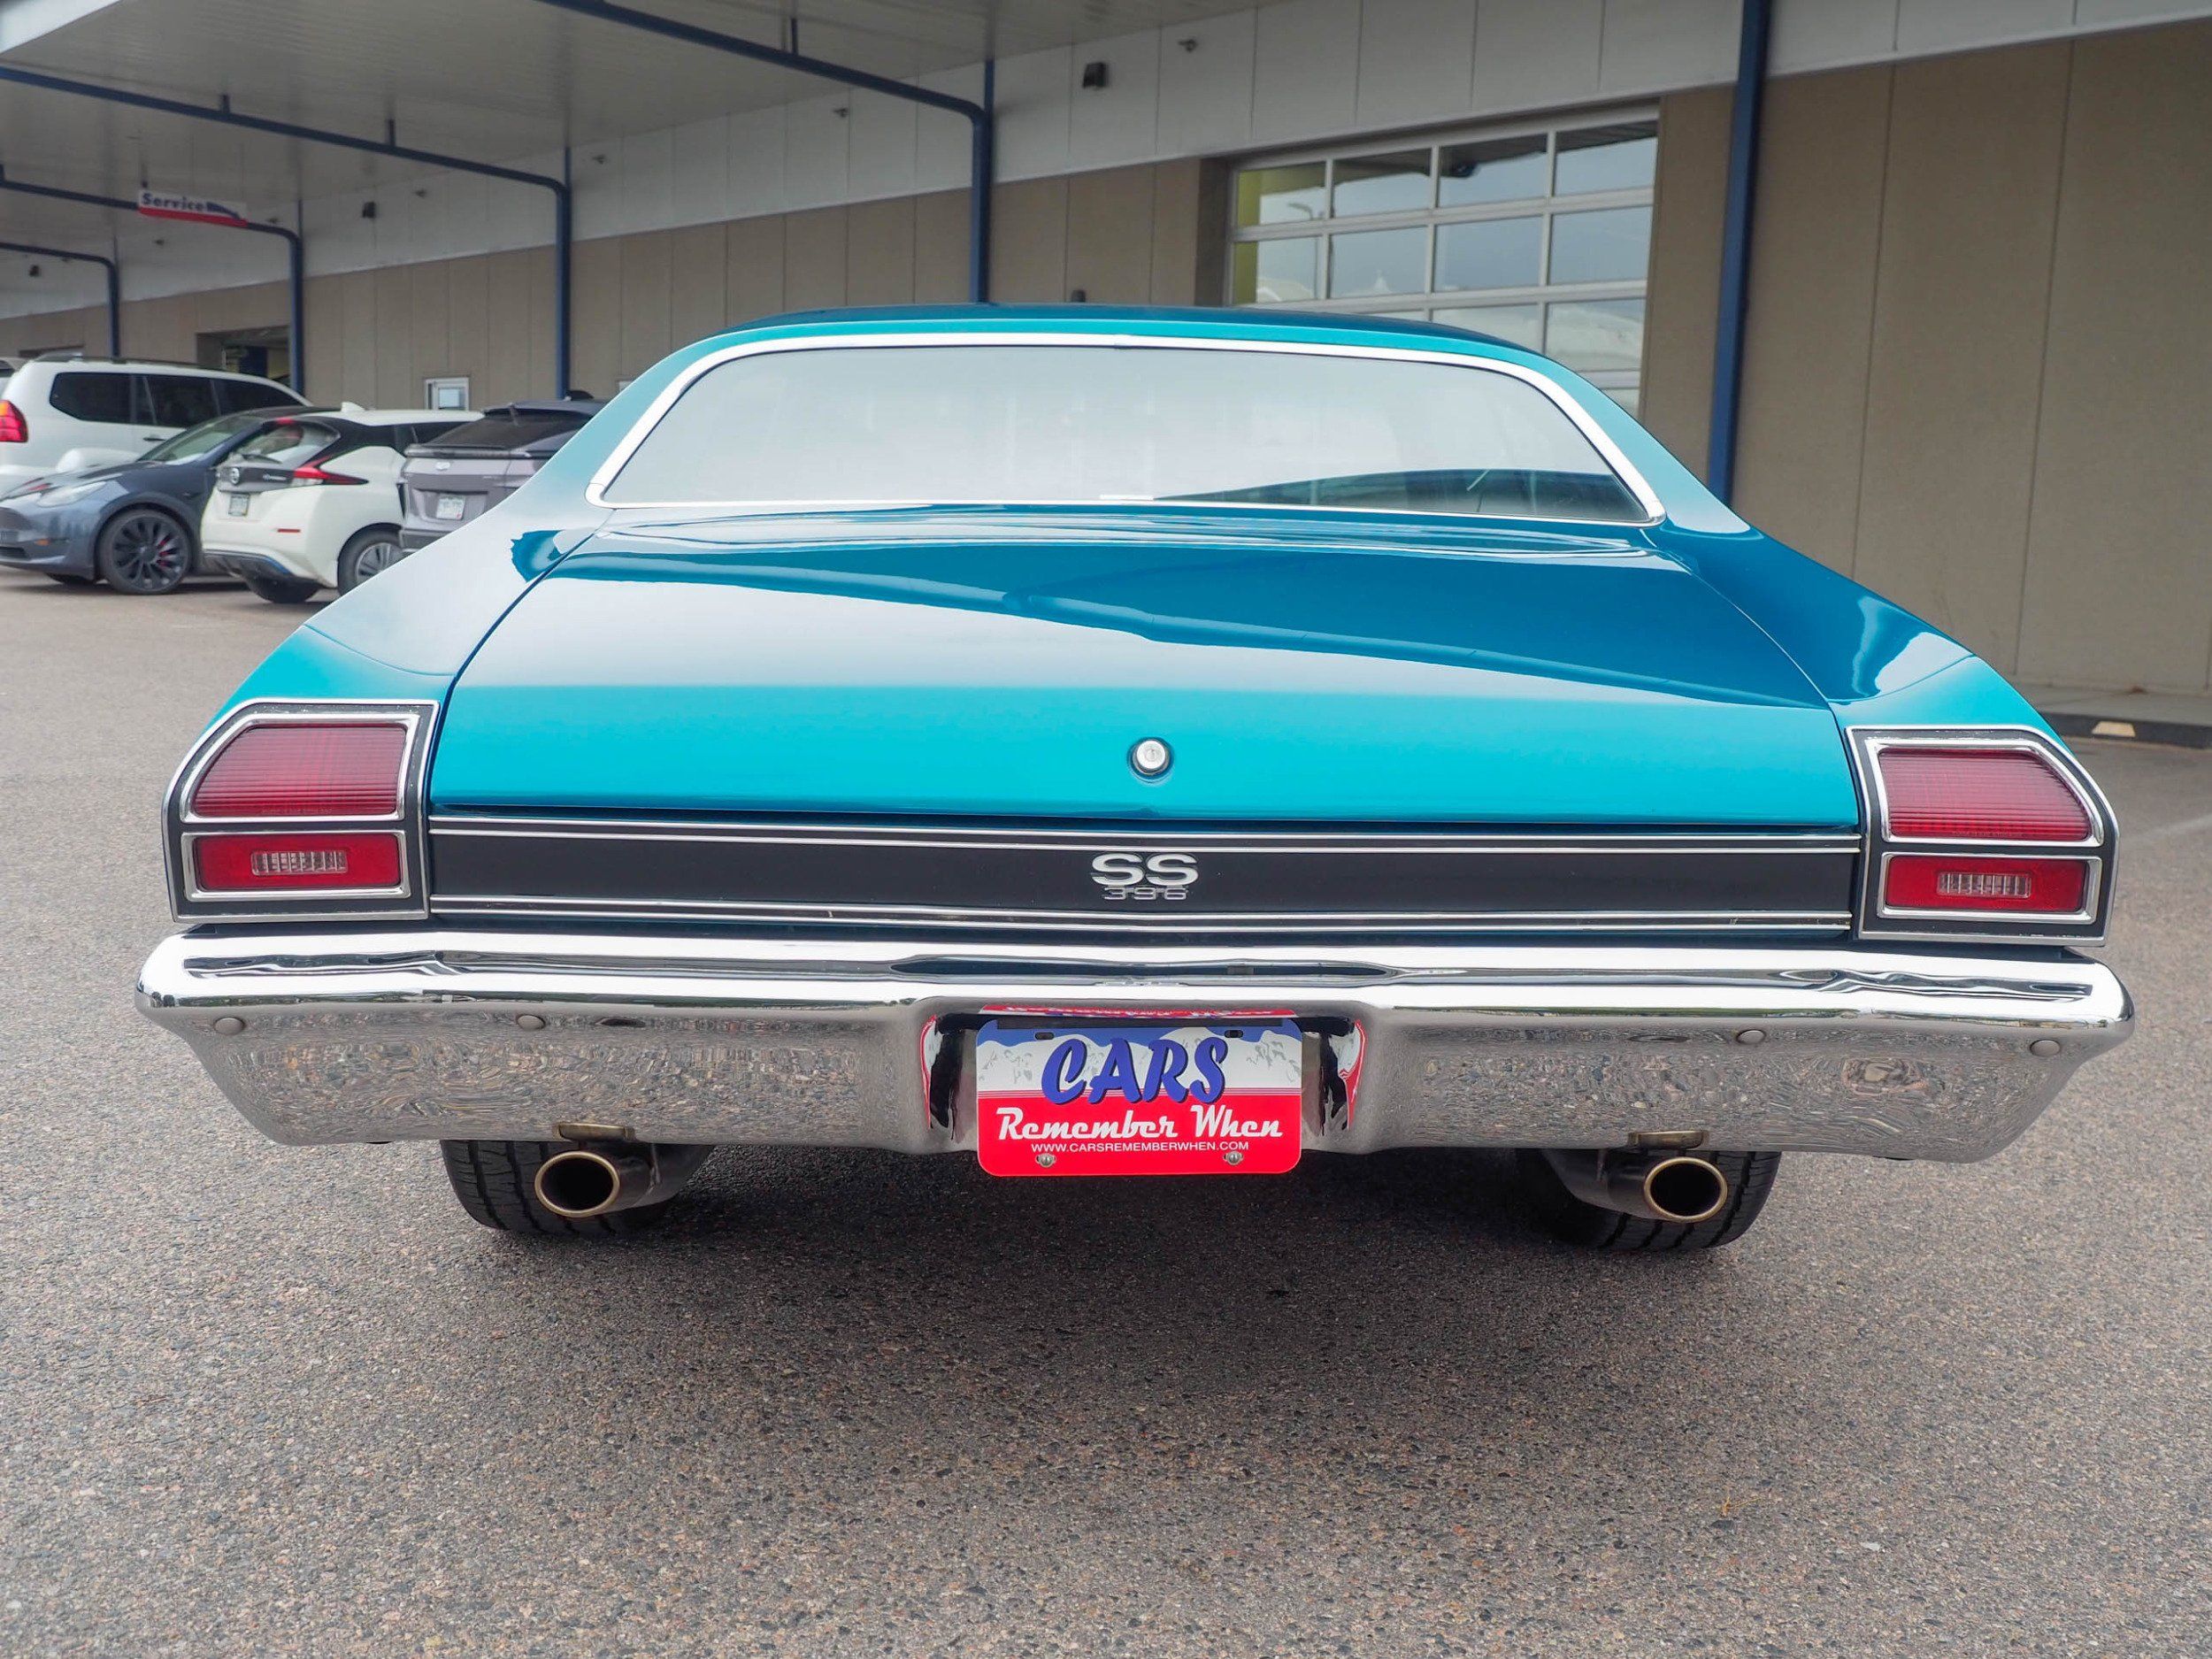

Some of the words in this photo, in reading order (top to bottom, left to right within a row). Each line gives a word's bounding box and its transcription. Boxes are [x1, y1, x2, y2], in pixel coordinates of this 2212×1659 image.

[142, 193, 204, 211] Service
[1091, 853, 1199, 886] SS
[1102, 886, 1188, 901] 396
[1041, 1037, 1228, 1103] CARS
[996, 1106, 1178, 1140] Remember
[1190, 1104, 1282, 1138] When
[1031, 1141, 1248, 1152] WWW.CARSREMEMBERWHEN.COM
